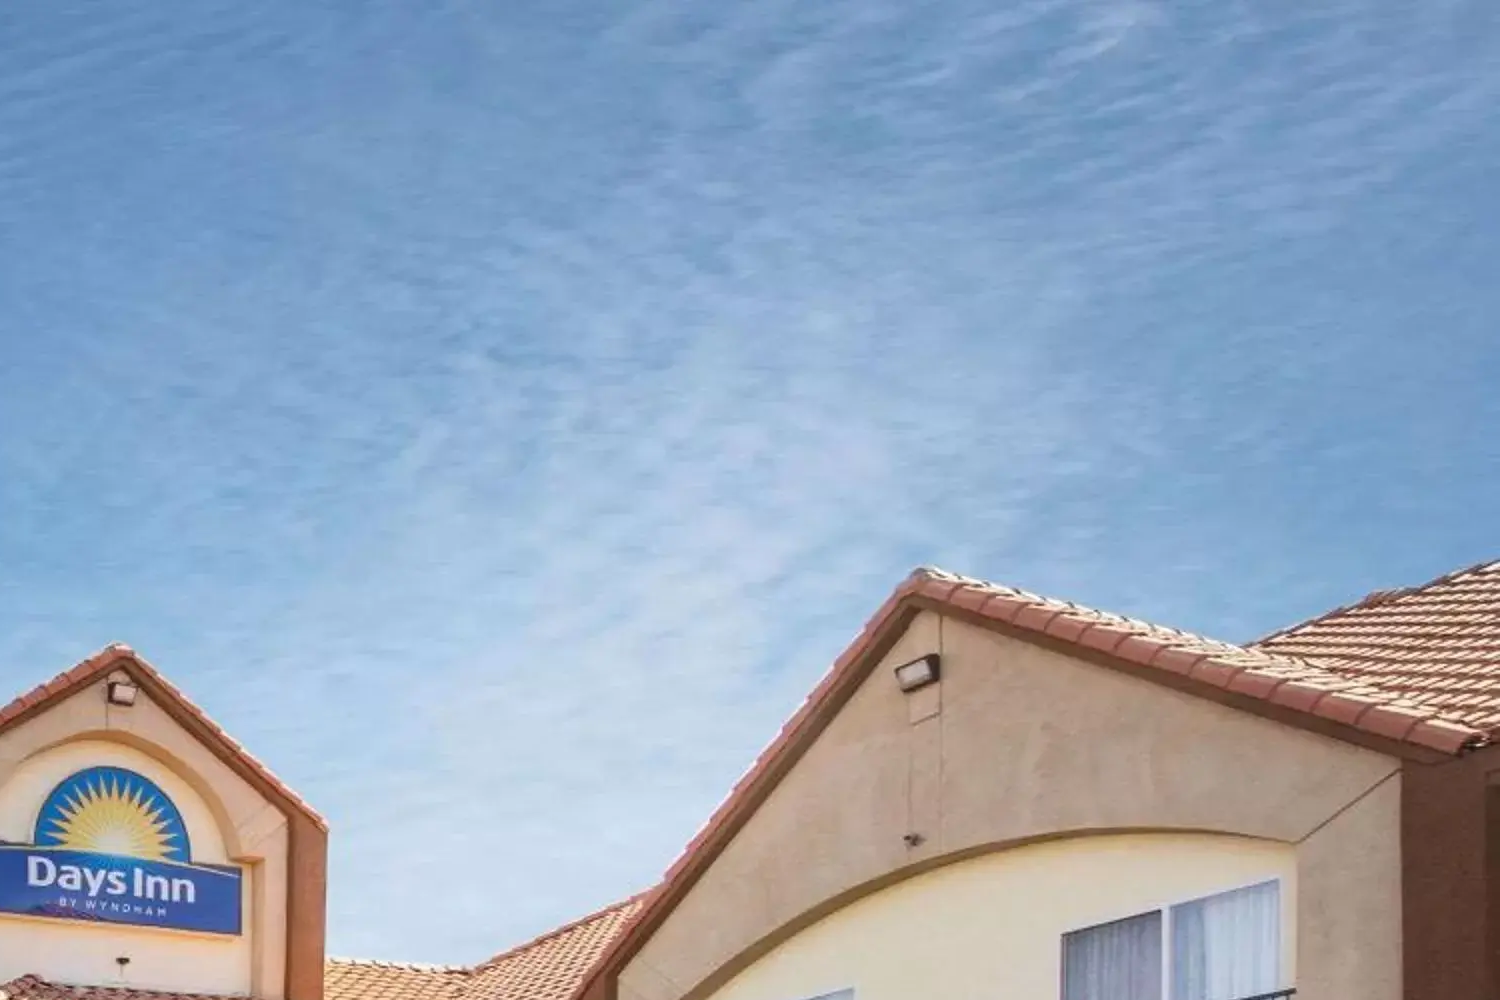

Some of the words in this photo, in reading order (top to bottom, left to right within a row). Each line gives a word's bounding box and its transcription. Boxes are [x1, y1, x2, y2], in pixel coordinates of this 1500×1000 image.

[26, 855, 127, 897] Days
[133, 867, 196, 903] Inn
[59, 896, 77, 907] BY
[85, 899, 167, 917] WYNDHAM
